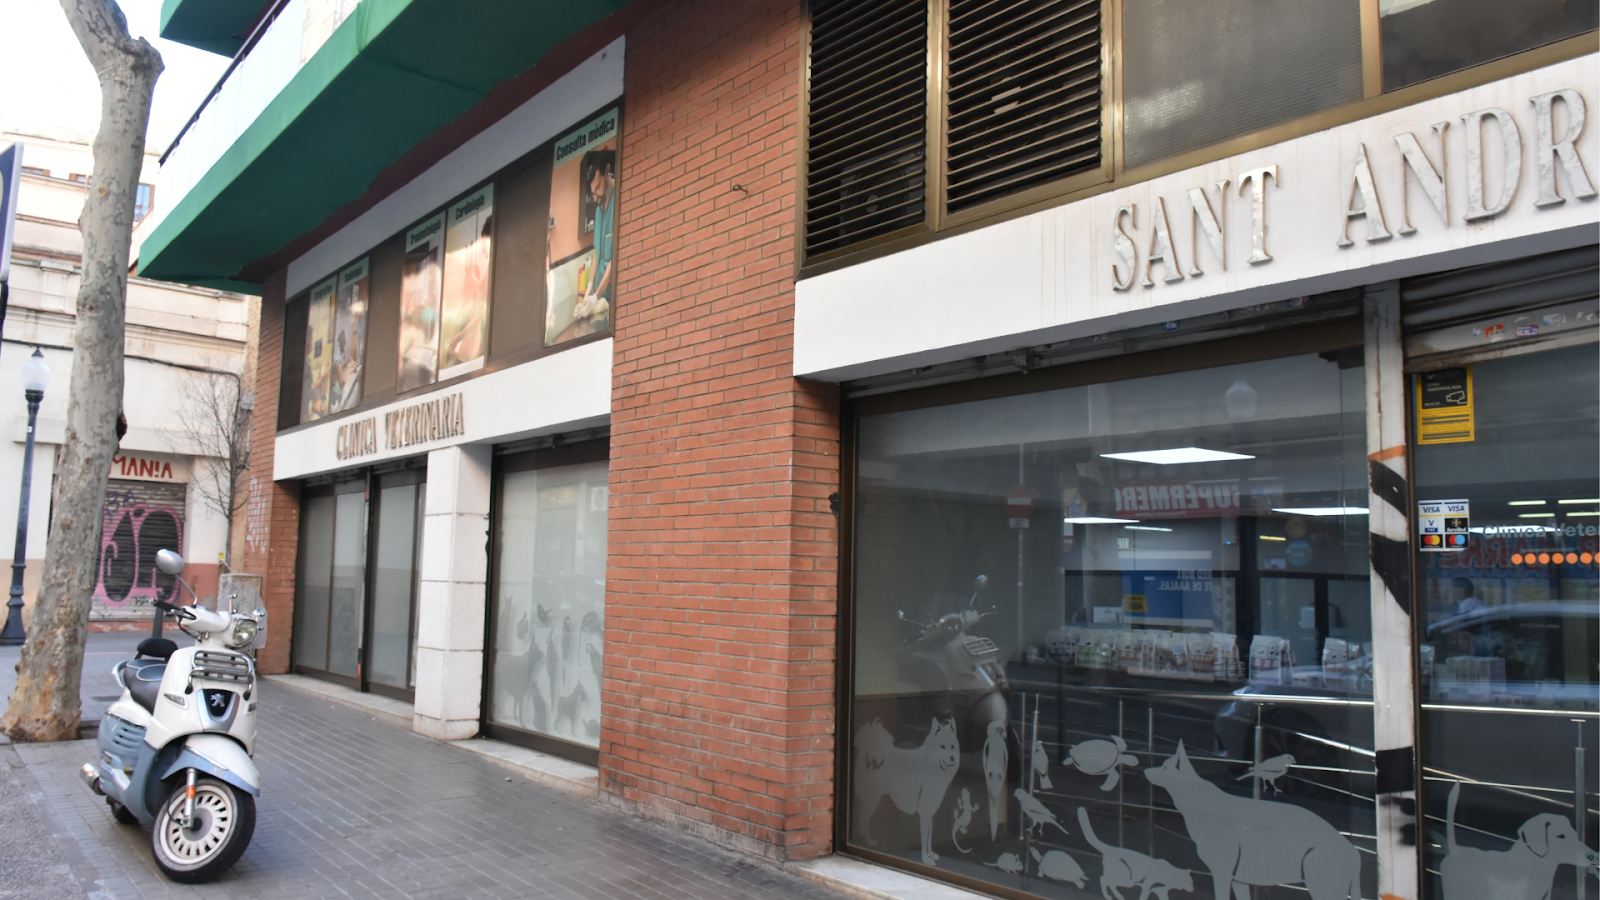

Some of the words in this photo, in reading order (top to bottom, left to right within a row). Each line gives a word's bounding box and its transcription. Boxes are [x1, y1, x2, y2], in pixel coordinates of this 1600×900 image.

[556, 134, 587, 161] Consulta
[588, 118, 615, 143] mèdica
[1112, 165, 1279, 293] SANT
[1336, 88, 1598, 248] ANDR
[336, 416, 377, 460] CLINICA
[384, 392, 465, 449] VETERINARIA
[1552, 522, 1599, 537] Vete
